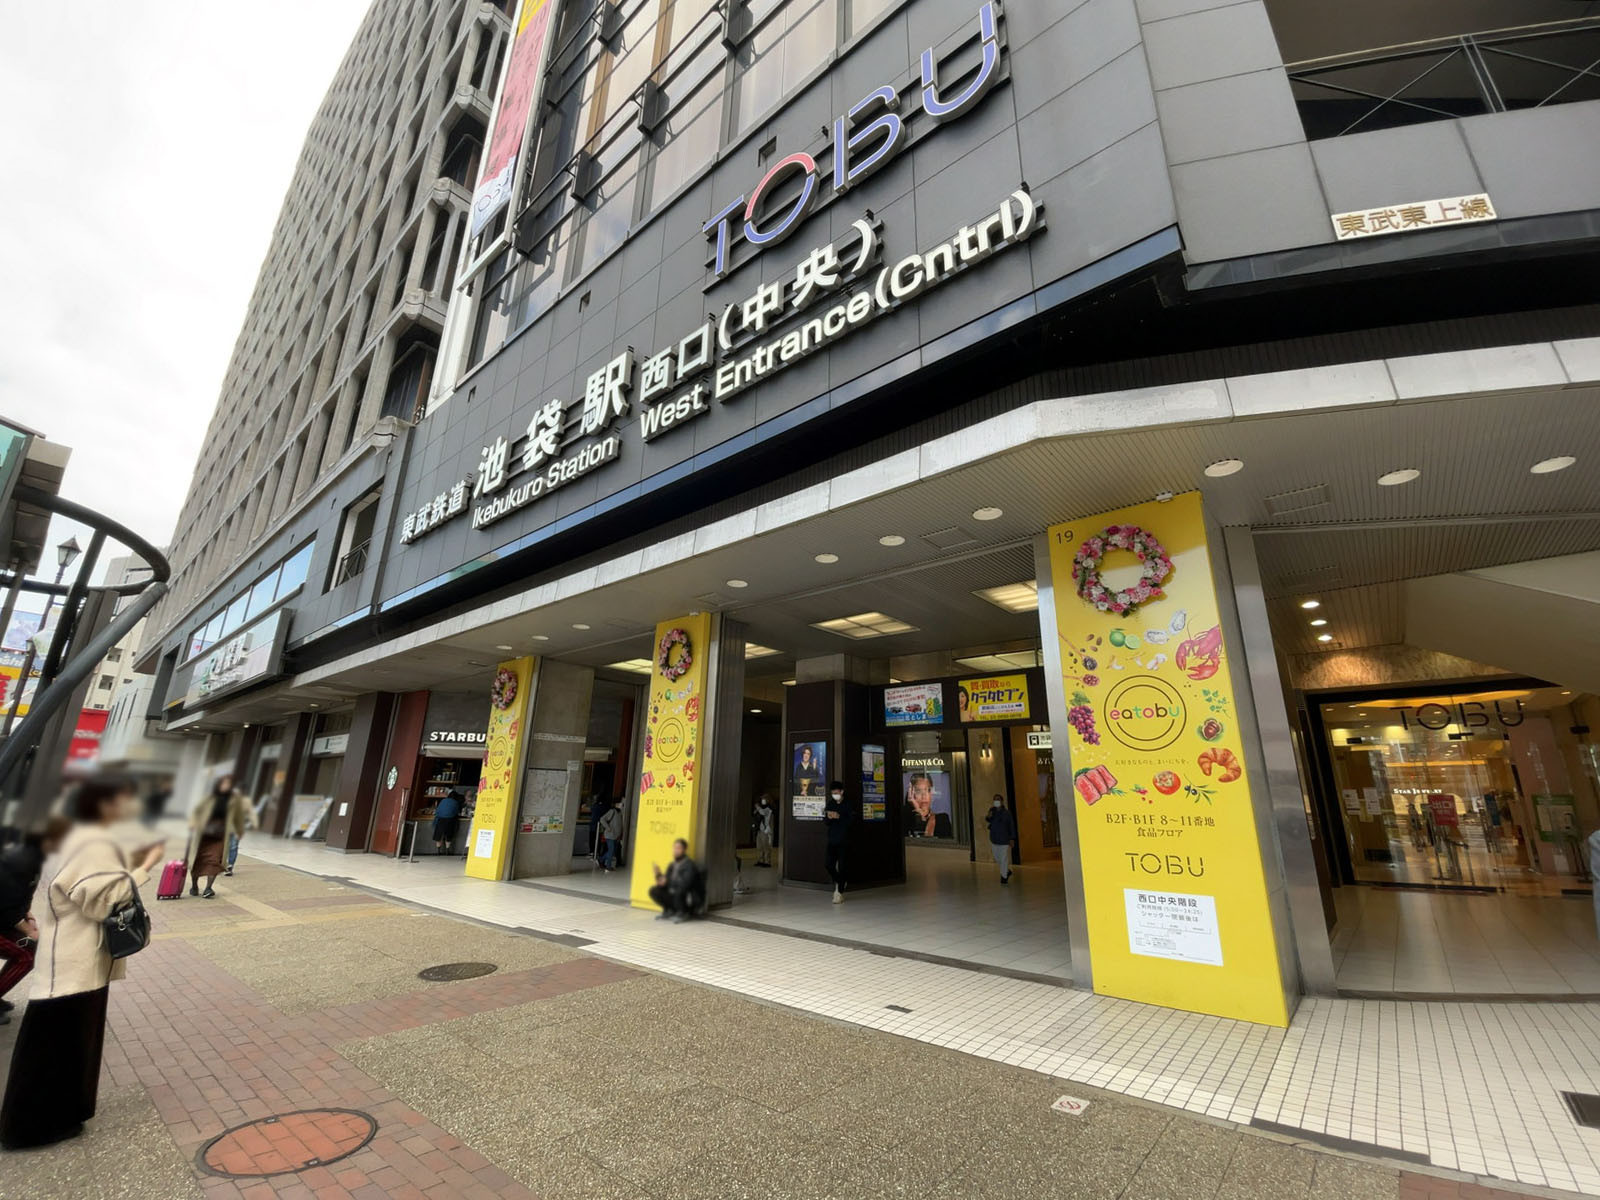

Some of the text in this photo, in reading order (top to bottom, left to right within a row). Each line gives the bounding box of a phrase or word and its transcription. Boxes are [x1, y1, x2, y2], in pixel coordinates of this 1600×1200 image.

[703, 1, 997, 278] TOBU
[1336, 197, 1494, 238] 東武東上線
[472, 477, 544, 530] Ikebukuro
[547, 436, 616, 490] Station
[640, 382, 704, 441] West
[715, 288, 871, 400] Entrance
[400, 480, 469, 544] 東武鉄道
[473, 350, 636, 502] 池袋駅
[1055, 529, 1074, 545] 19
[1109, 703, 1180, 721] eatobu
[1389, 699, 1524, 731] TOBU
[1137, 827, 1183, 838] 食品フロア
[1125, 852, 1204, 878] TOBU
[1138, 893, 1197, 907] 西口中央階段
